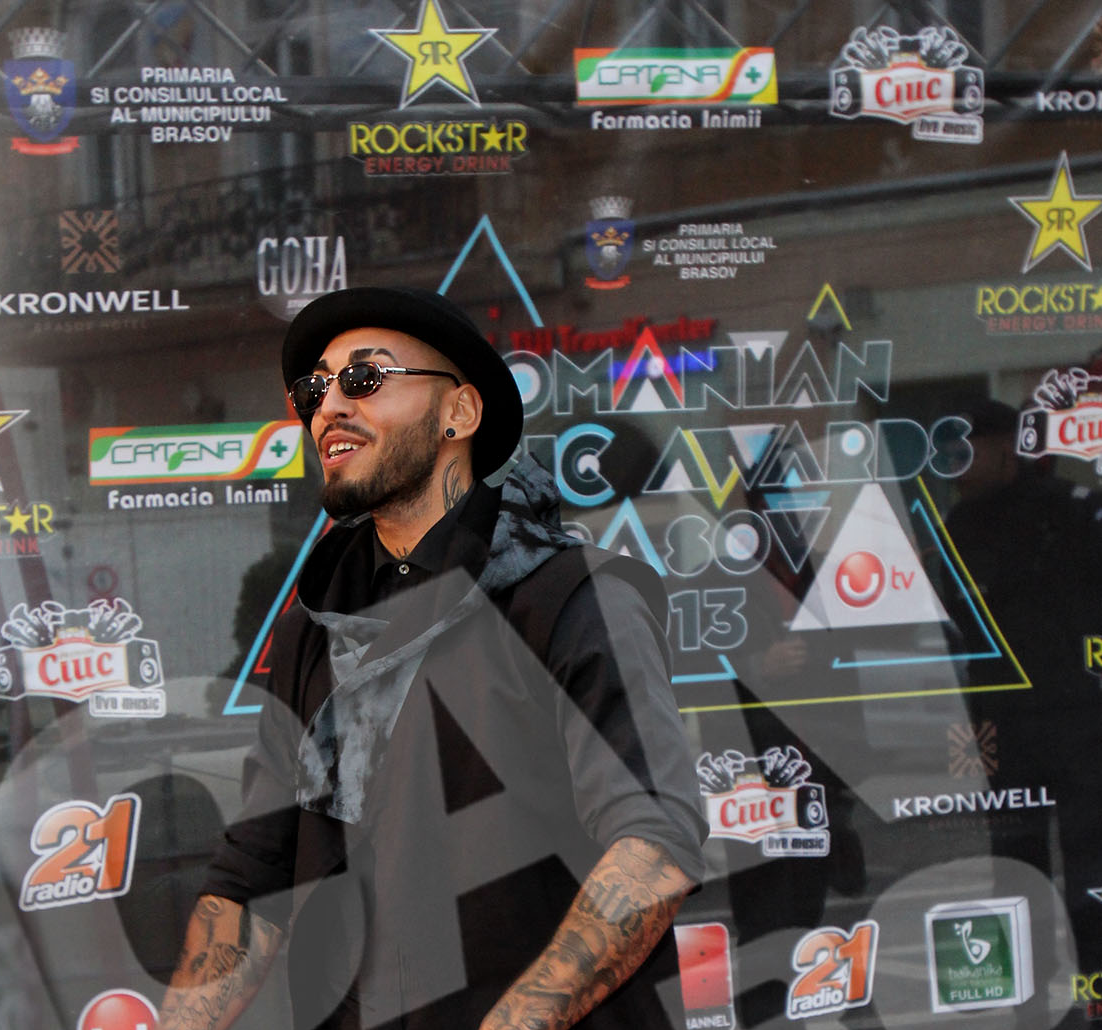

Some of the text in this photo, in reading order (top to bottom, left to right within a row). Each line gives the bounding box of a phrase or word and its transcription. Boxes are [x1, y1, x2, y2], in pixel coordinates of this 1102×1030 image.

[140, 66, 236, 84] PRIMARIA
[598, 64, 722, 86] CATENA
[90, 86, 289, 104] SI CONSILIUL LOCAL
[875, 75, 942, 108] Ciuc
[1036, 89, 1102, 112] KRO
[110, 105, 272, 124] AL MUNICIPIULUI
[591, 109, 762, 130] Farmacia Inimii
[151, 126, 234, 144] BRASOV
[365, 154, 512, 174] ENERGY DRINK
[679, 223, 744, 236] PRIMARIA
[642, 236, 777, 252] SI CONSILIUL LOCAL
[257, 235, 348, 295] GOHA
[654, 252, 765, 265] AL MUNICIPIULUI
[680, 267, 738, 280] BRASOV
[501, 327, 893, 418] OMANIAN
[110, 440, 243, 465] CATENA
[643, 416, 974, 509] AWARDS
[108, 484, 289, 510] Farmacia Inimii
[670, 588, 748, 650] 13
[38, 648, 115, 688] Ciuc
[719, 795, 785, 829] Ciuc
[894, 786, 1056, 818] KRONWELL
[33, 798, 137, 891] 21
[27, 875, 94, 903] radio
[796, 926, 875, 1001] 21
[792, 988, 844, 1013] radio
[950, 985, 1004, 1002] FULL HD
